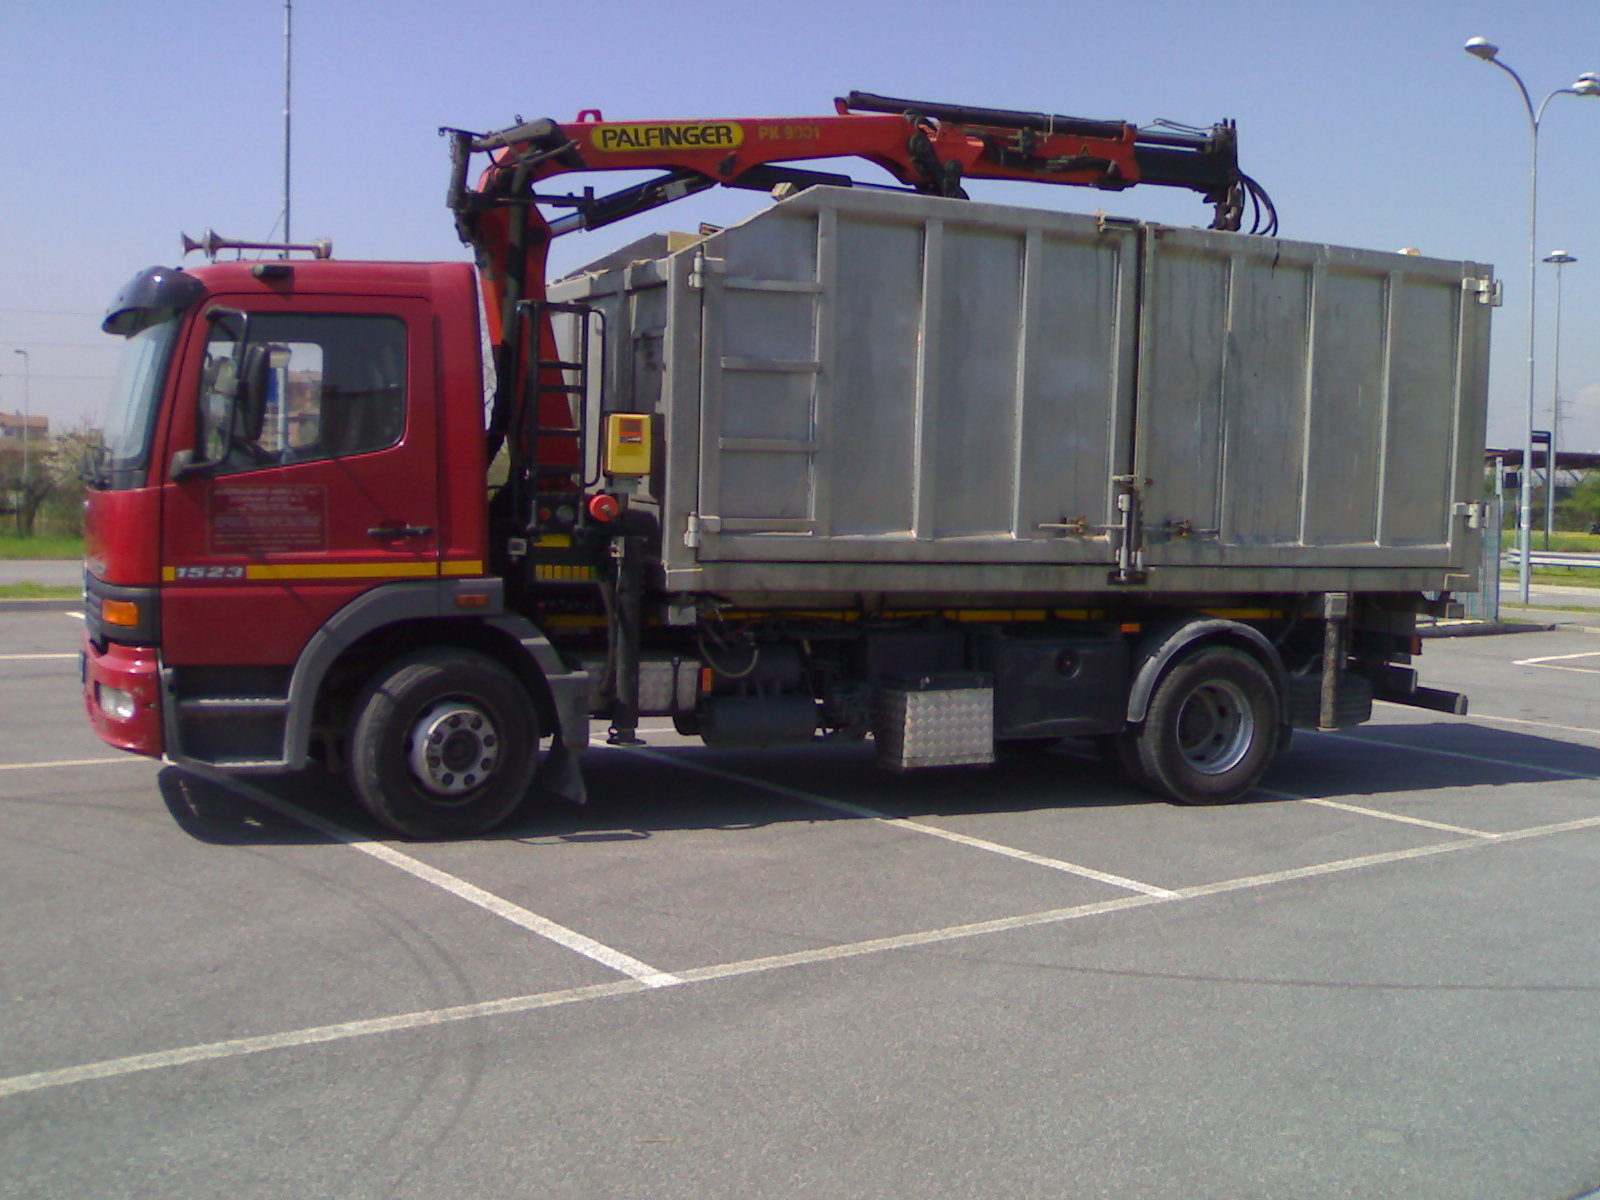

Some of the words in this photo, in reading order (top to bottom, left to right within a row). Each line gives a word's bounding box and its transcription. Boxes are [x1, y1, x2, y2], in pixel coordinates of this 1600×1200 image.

[602, 125, 733, 148] PALFINGER
[758, 125, 780, 140] PK
[176, 567, 243, 578] 1523
